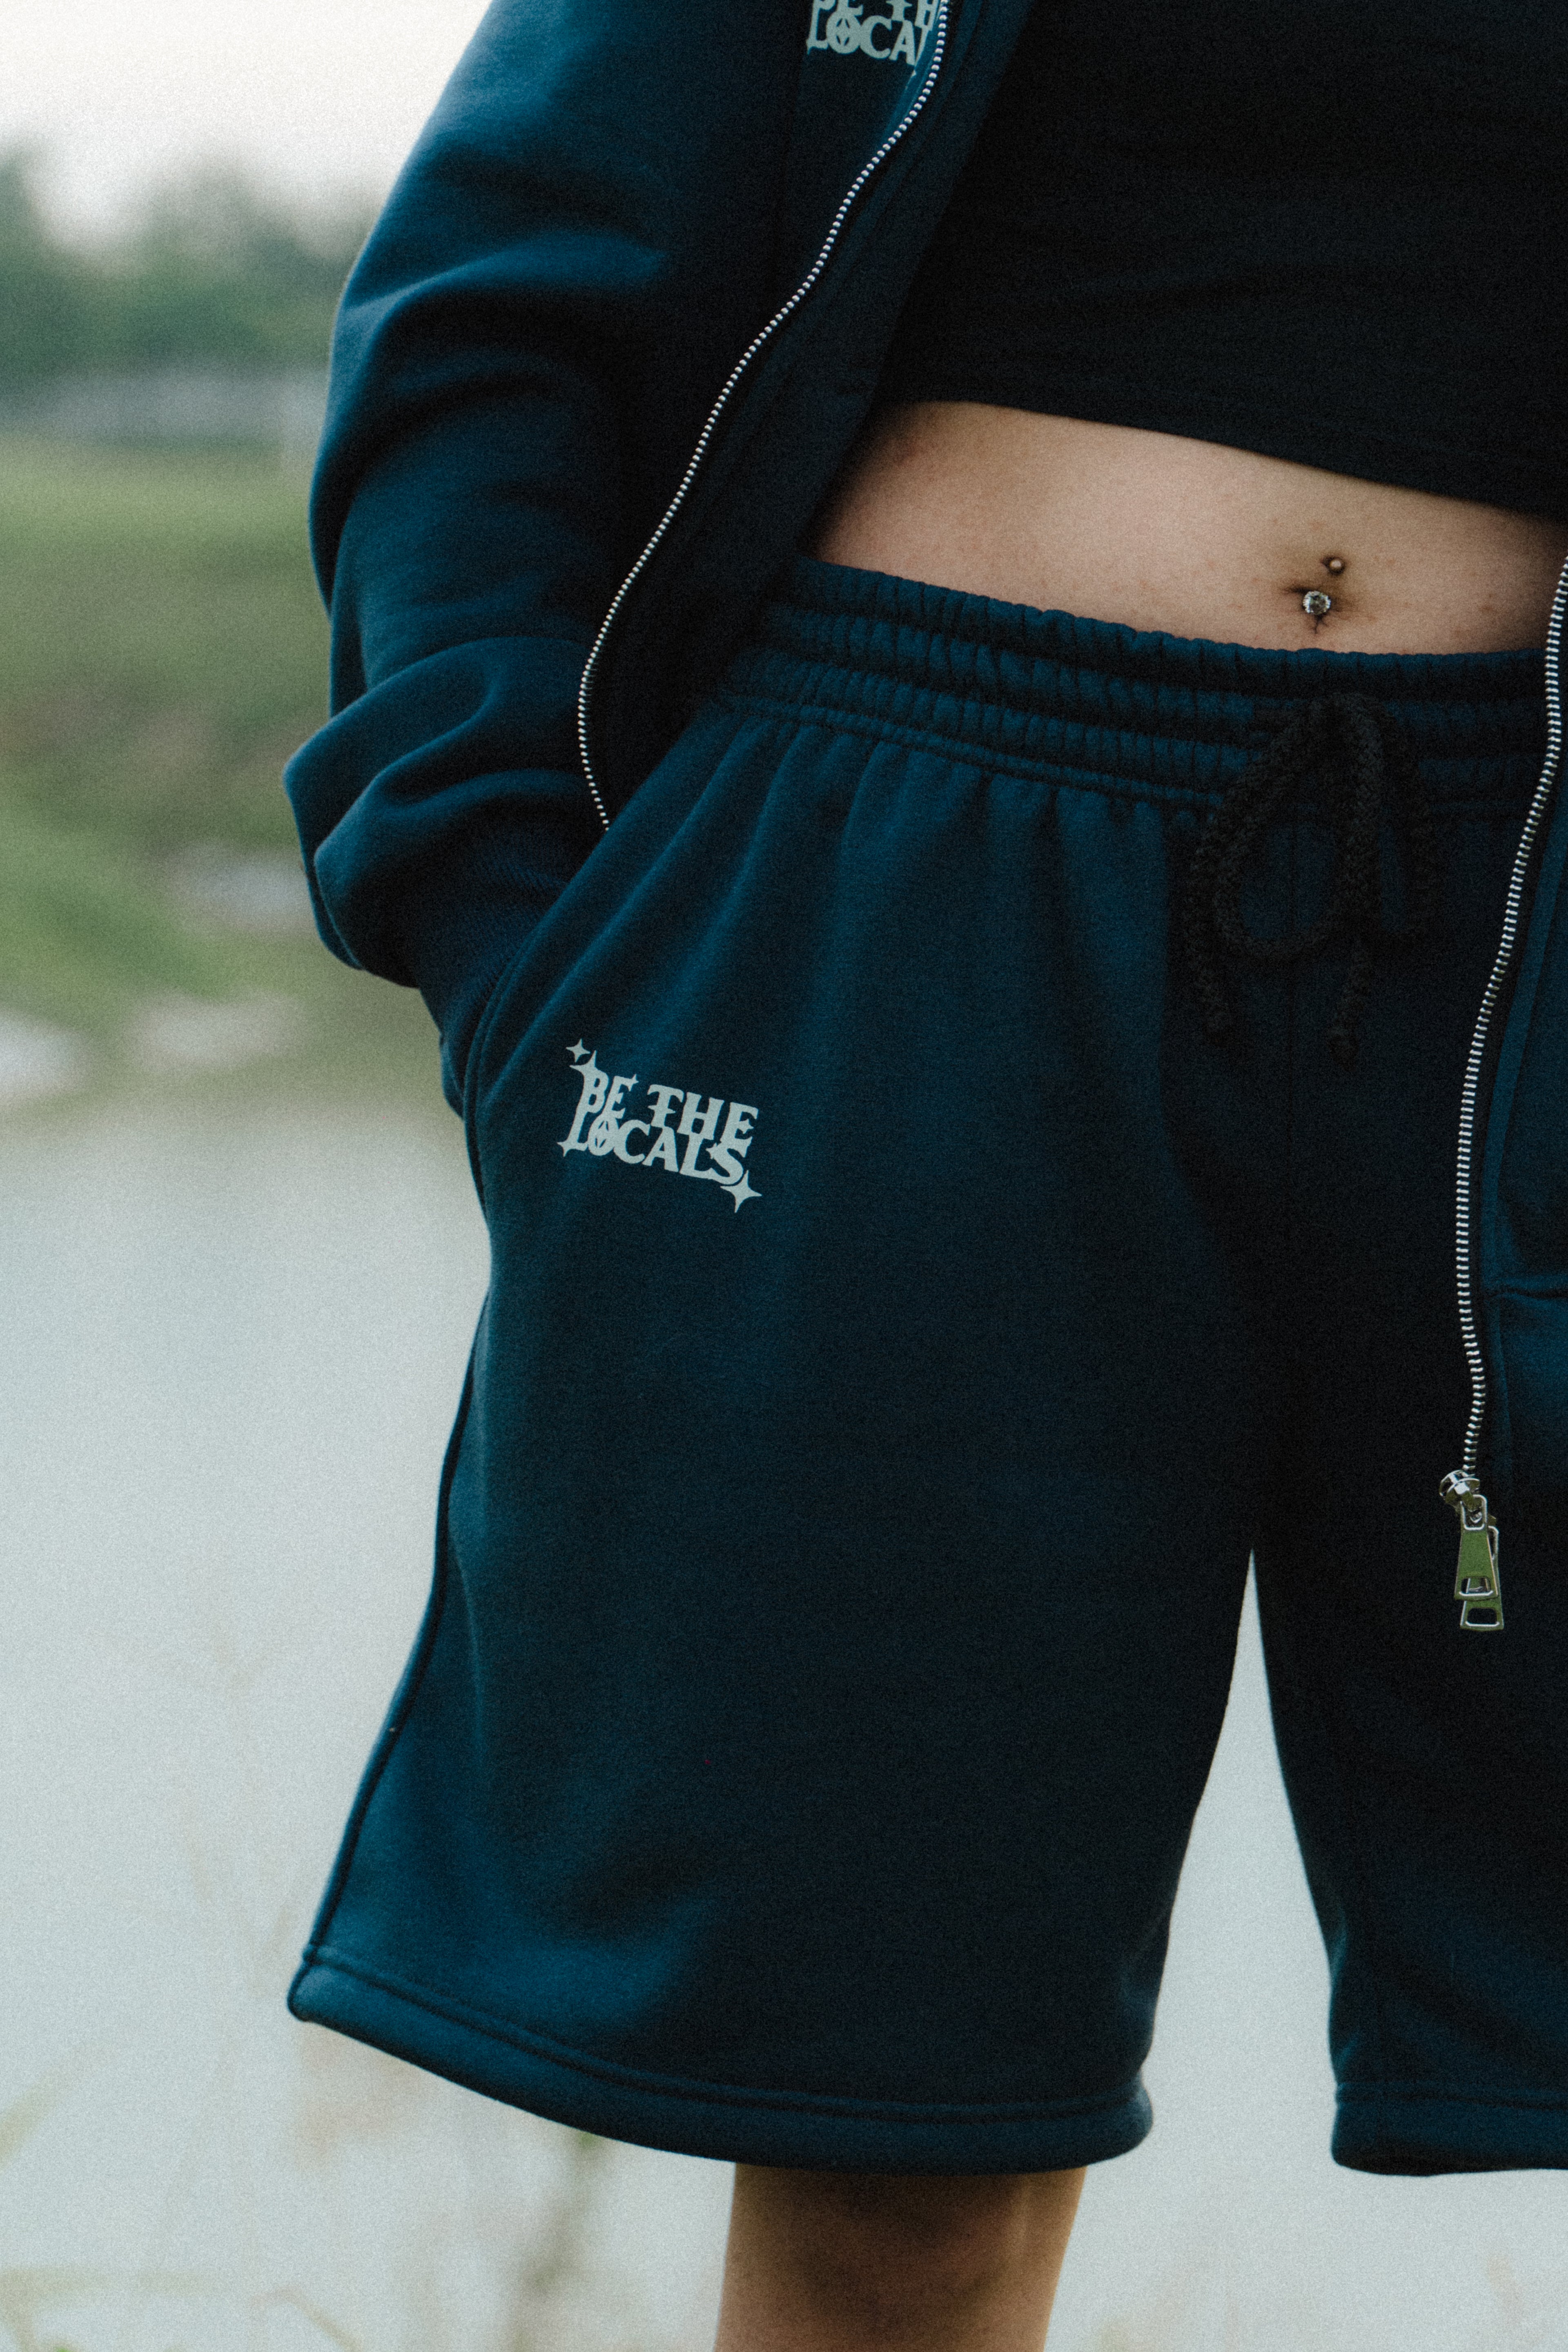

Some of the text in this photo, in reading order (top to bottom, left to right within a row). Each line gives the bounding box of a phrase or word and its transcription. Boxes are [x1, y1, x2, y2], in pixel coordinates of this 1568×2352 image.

[569, 1050, 759, 1157] BE THE
[557, 1113, 744, 1185] LOCALS
